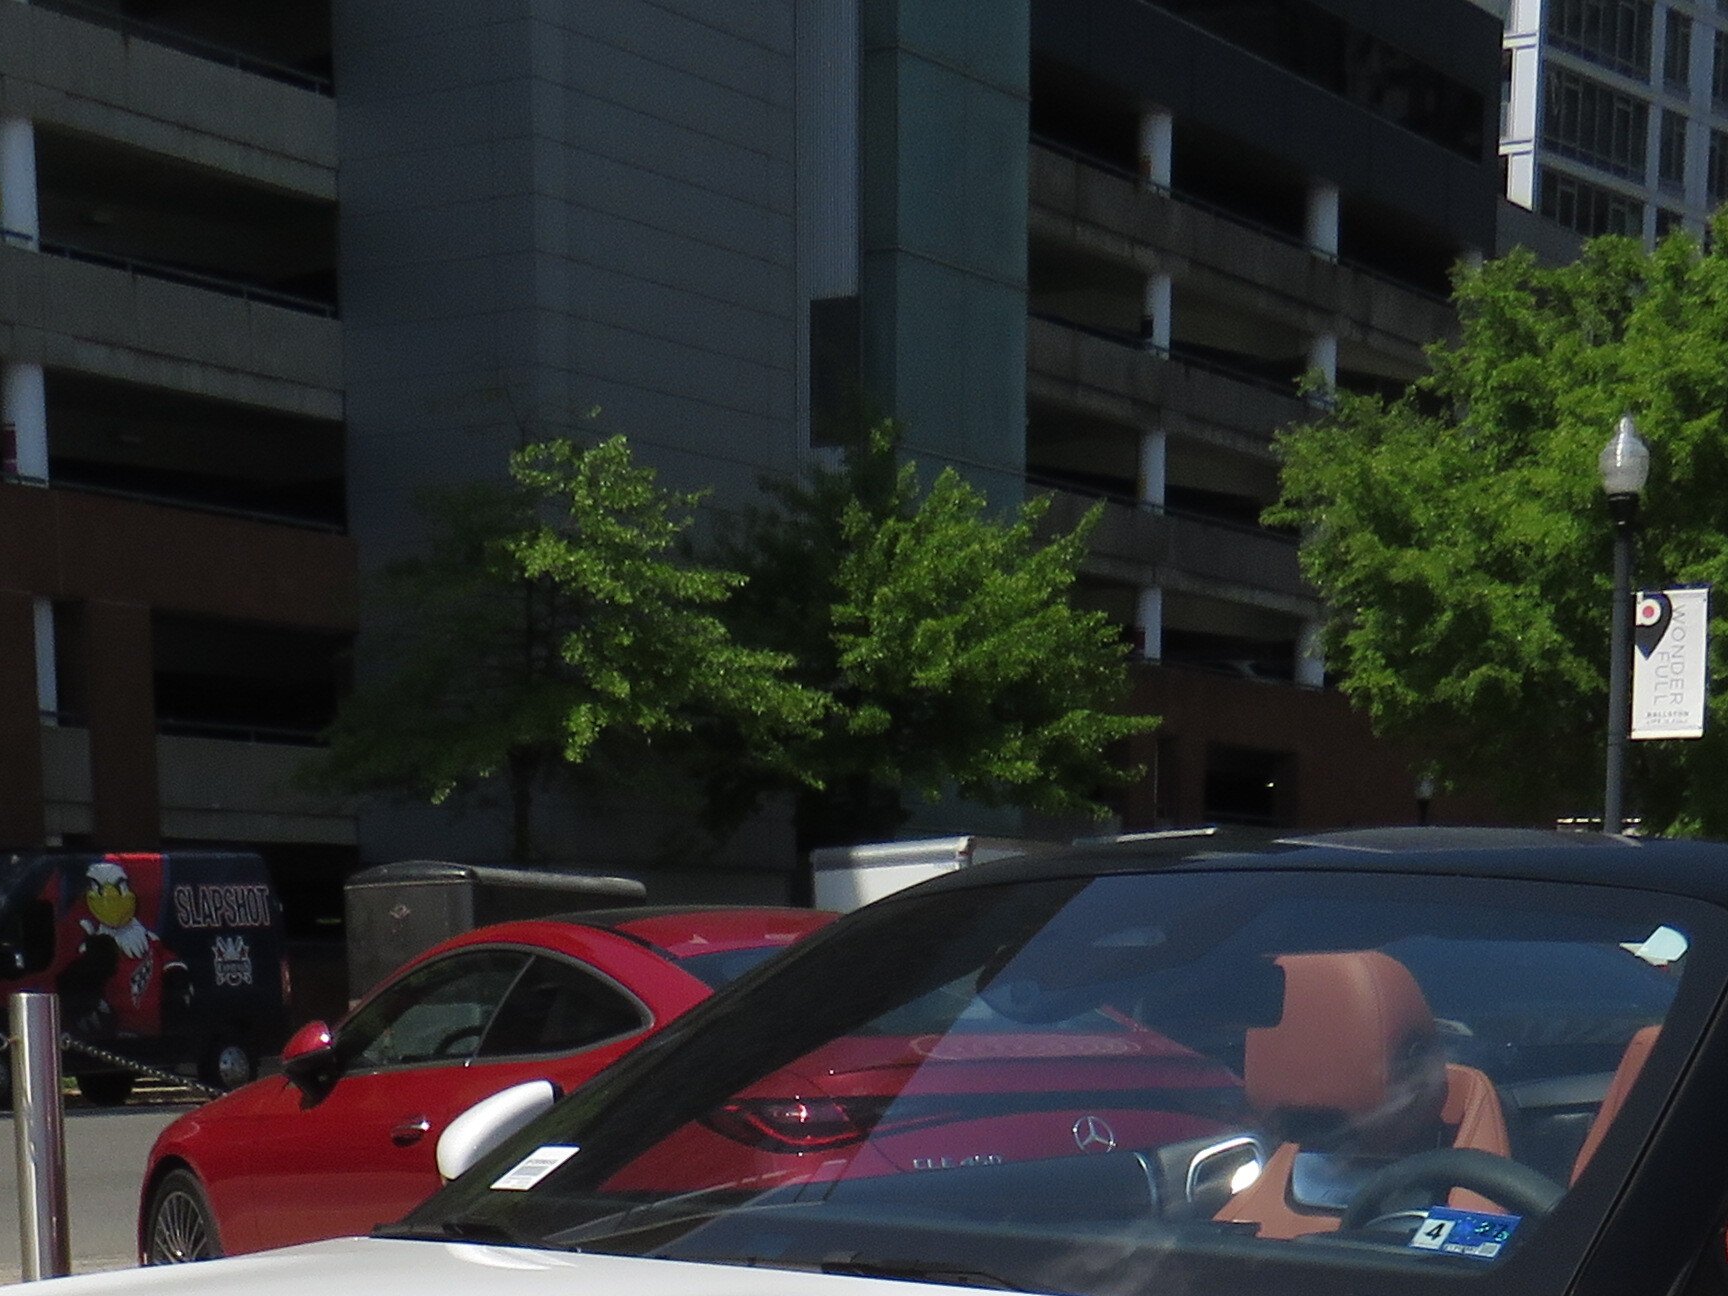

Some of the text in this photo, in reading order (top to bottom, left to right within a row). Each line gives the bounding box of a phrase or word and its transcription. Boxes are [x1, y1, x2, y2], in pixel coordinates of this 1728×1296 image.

[1654, 651, 1670, 705] FULL
[1671, 604, 1685, 705] WONDER
[174, 885, 271, 928] SLAPSHOT
[1424, 1222, 1446, 1241] 4
